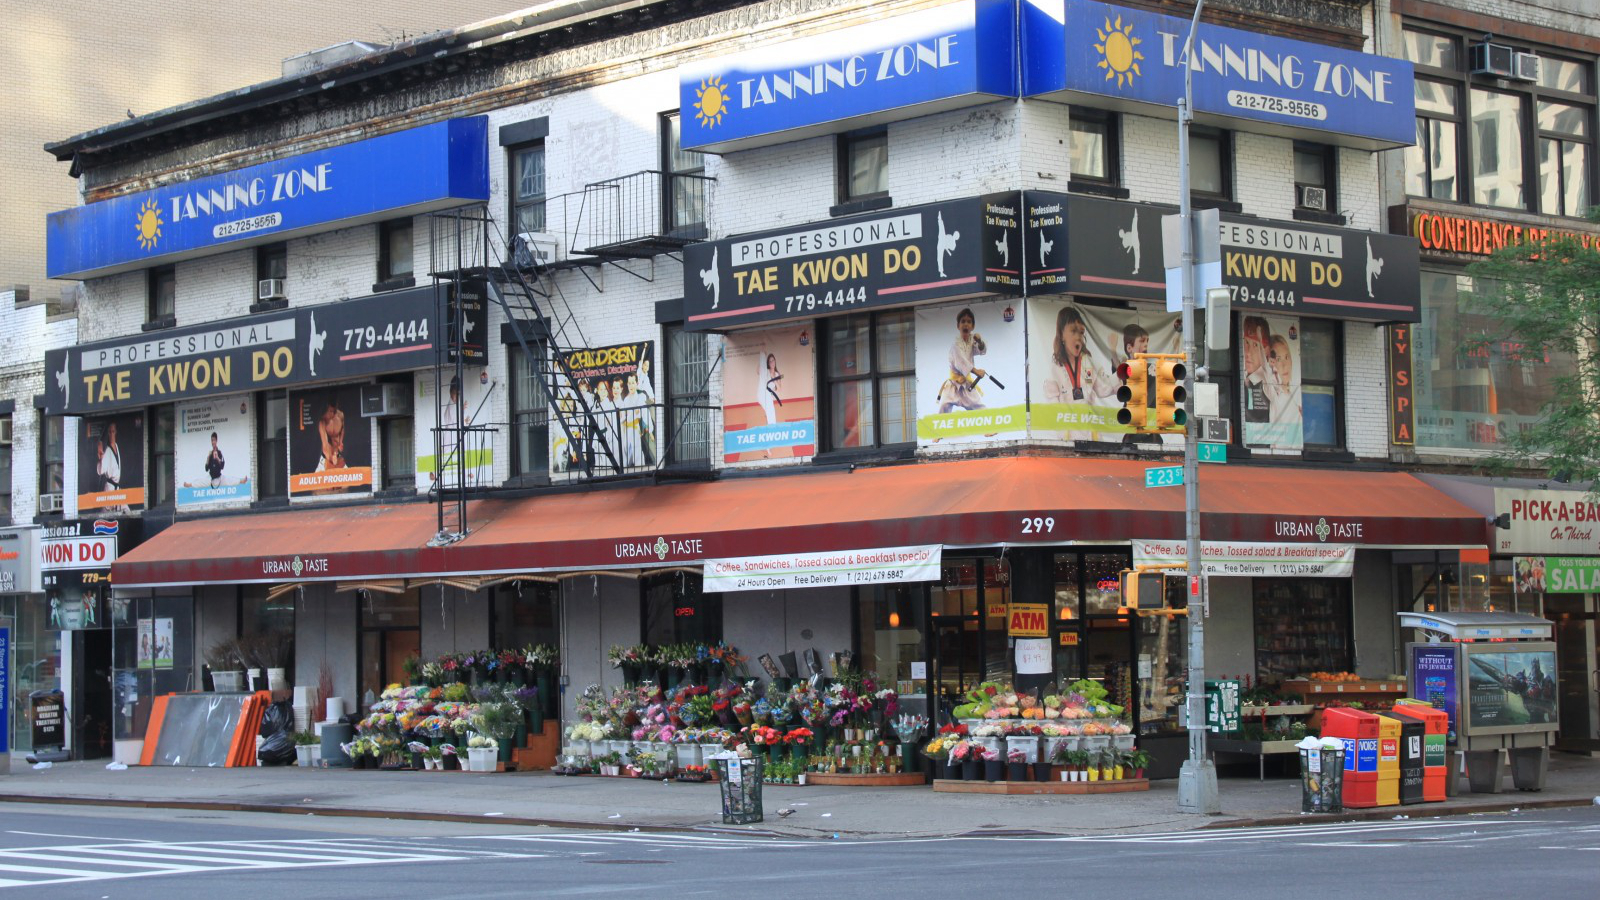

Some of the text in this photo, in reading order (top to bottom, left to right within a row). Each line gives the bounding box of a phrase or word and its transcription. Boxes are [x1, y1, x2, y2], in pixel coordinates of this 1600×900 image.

[737, 34, 959, 109] TANNING ZONE
[1157, 31, 1393, 104] TANNING ZONE
[1236, 94, 1318, 118] 212-725-9556
[169, 162, 332, 222] TANNING ZONE
[218, 214, 276, 236] 212-725-9556
[986, 216, 1016, 228] Tae Kwon Do
[1030, 216, 1062, 228] Tae Kwon Do
[742, 220, 910, 261] PROFESSIONAL
[1220, 224, 1335, 254] FESSIONAL
[1418, 214, 1522, 254] CONFIDENCE
[734, 245, 921, 296] TAE KWON DO
[1226, 252, 1342, 288] KWON DO
[785, 286, 866, 313] 779-4444
[344, 318, 428, 351] 779-4444
[100, 325, 272, 366] PROFESSIONAL
[84, 346, 293, 404] TAE KWON DO
[608, 364, 637, 375] Discipline
[932, 414, 1012, 430] TAE KWON DO
[1056, 412, 1078, 423] PEE
[1080, 413, 1105, 425] WEE
[737, 429, 806, 444] TAE KWON DO
[1204, 445, 1211, 459] 3
[299, 473, 363, 486] ADULT PROGRAMS
[1146, 468, 1183, 485] E 23 ST
[192, 487, 237, 498] TAE KWON DO
[1021, 517, 1055, 533] 299
[1275, 521, 1363, 537] URBAN TASTE
[1550, 526, 1592, 540] On Third
[79, 542, 106, 562] DO
[615, 539, 702, 558] URBAN TASTE
[1144, 544, 1345, 559] Coffee, Saiches, Tossed salad & Breakfast special
[263, 559, 328, 574] URBAN TASTE
[715, 550, 929, 573] Coffee, Sandwiches, Tossed salad & Breakfast special
[1224, 564, 1238, 572] Free
[1240, 564, 1264, 574] Delivery
[1279, 564, 1297, 574] (212)
[1298, 565, 1309, 573] 679
[3, 582, 14, 591] SPA
[737, 578, 746, 587] 24
[747, 578, 766, 586] Hours
[767, 577, 785, 588] Open
[794, 576, 808, 584] Free
[810, 574, 838, 584] Delivery
[854, 572, 871, 582] (212)
[873, 571, 886, 580] 679
[887, 570, 904, 579] 5843
[1097, 580, 1119, 589] OPEN
[1552, 568, 1600, 590] SALA
[675, 608, 694, 616] OPEN
[990, 606, 1005, 614] ATM
[1011, 612, 1045, 630] ATM
[1421, 618, 1440, 628] Phone
[1062, 634, 1076, 642] ATM
[36, 718, 60, 726] TREATMENT
[1359, 741, 1377, 750] VOICE
[1426, 743, 1444, 752] metro
